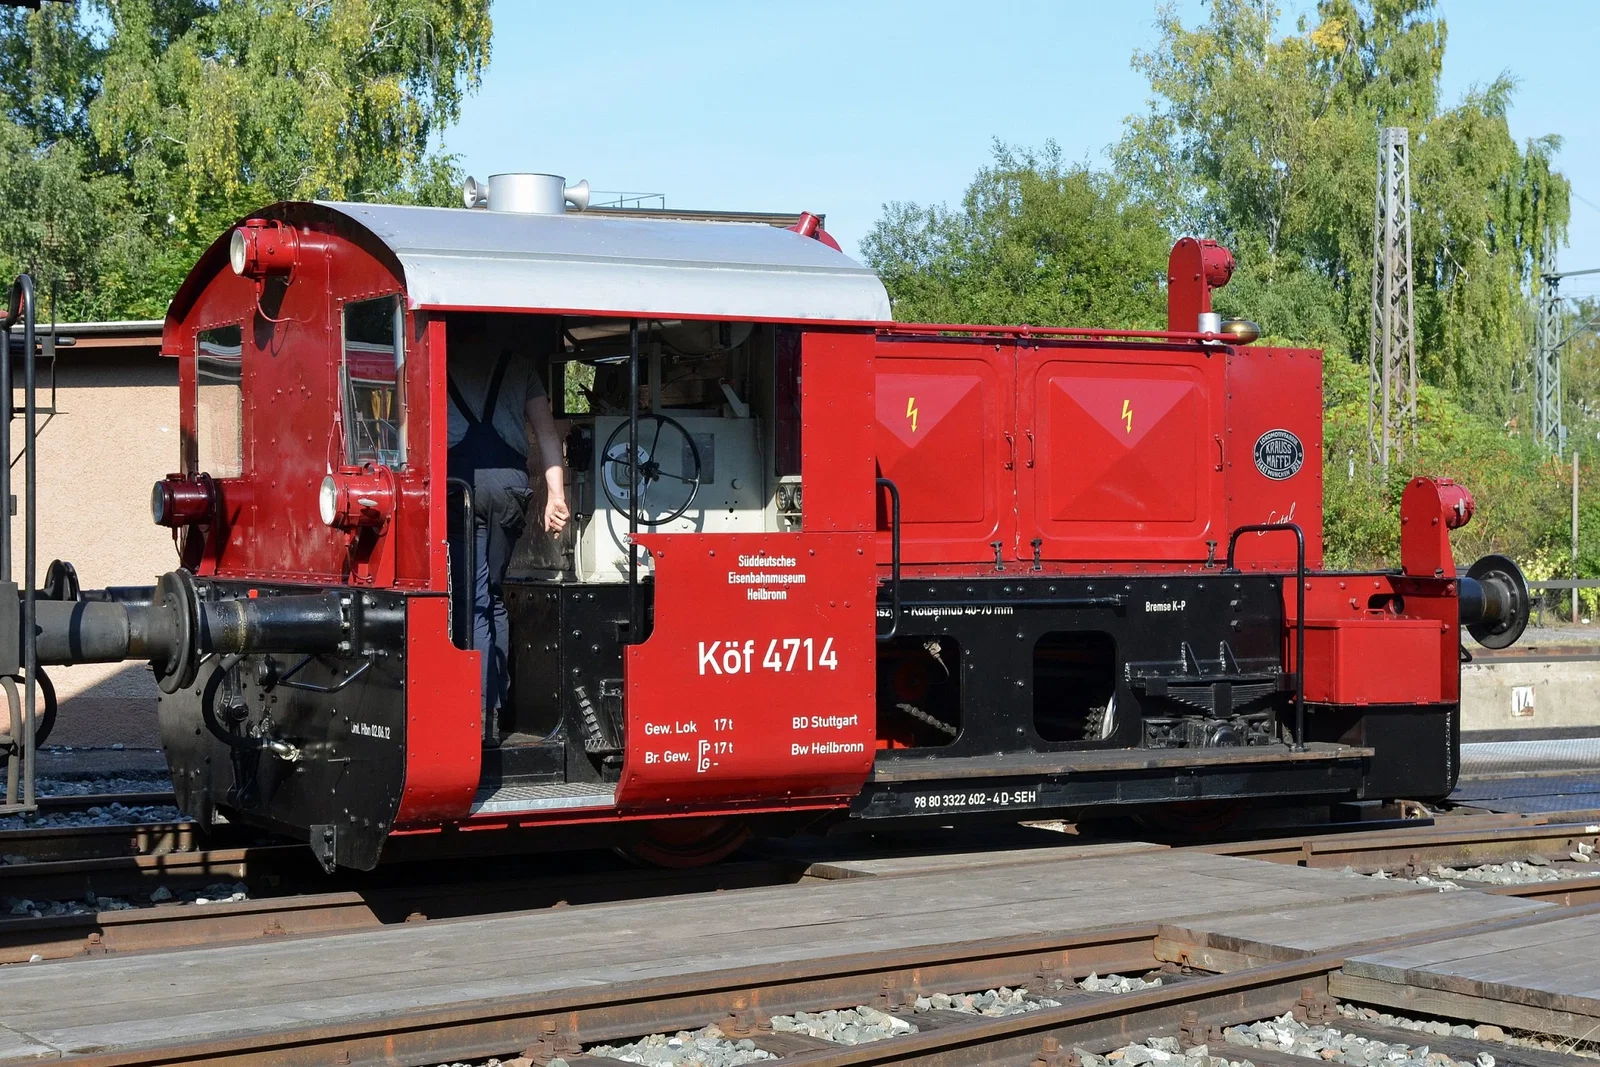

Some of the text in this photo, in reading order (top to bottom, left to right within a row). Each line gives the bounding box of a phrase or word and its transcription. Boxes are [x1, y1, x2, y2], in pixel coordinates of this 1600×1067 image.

[1265, 440, 1292, 454] KRAUSS
[1266, 455, 1291, 468] MAFFEI
[738, 555, 796, 567] Süddeutsches
[728, 571, 806, 584] Eisenbahnmuseum
[747, 588, 787, 600] Heilbronn
[994, 606, 1014, 615] mm
[1145, 600, 1186, 612] Bremse K-P
[698, 637, 838, 676] Köf 4714
[1516, 690, 1531, 713] 14
[644, 722, 672, 735] Gew.
[675, 720, 697, 734] Lok
[792, 714, 858, 729] BD Stuttgart
[791, 741, 864, 756] Bw Heilbronn
[645, 750, 691, 764] Br. Gew.
[914, 796, 927, 808] 98
[928, 795, 941, 807] 80
[942, 794, 966, 806] 3322
